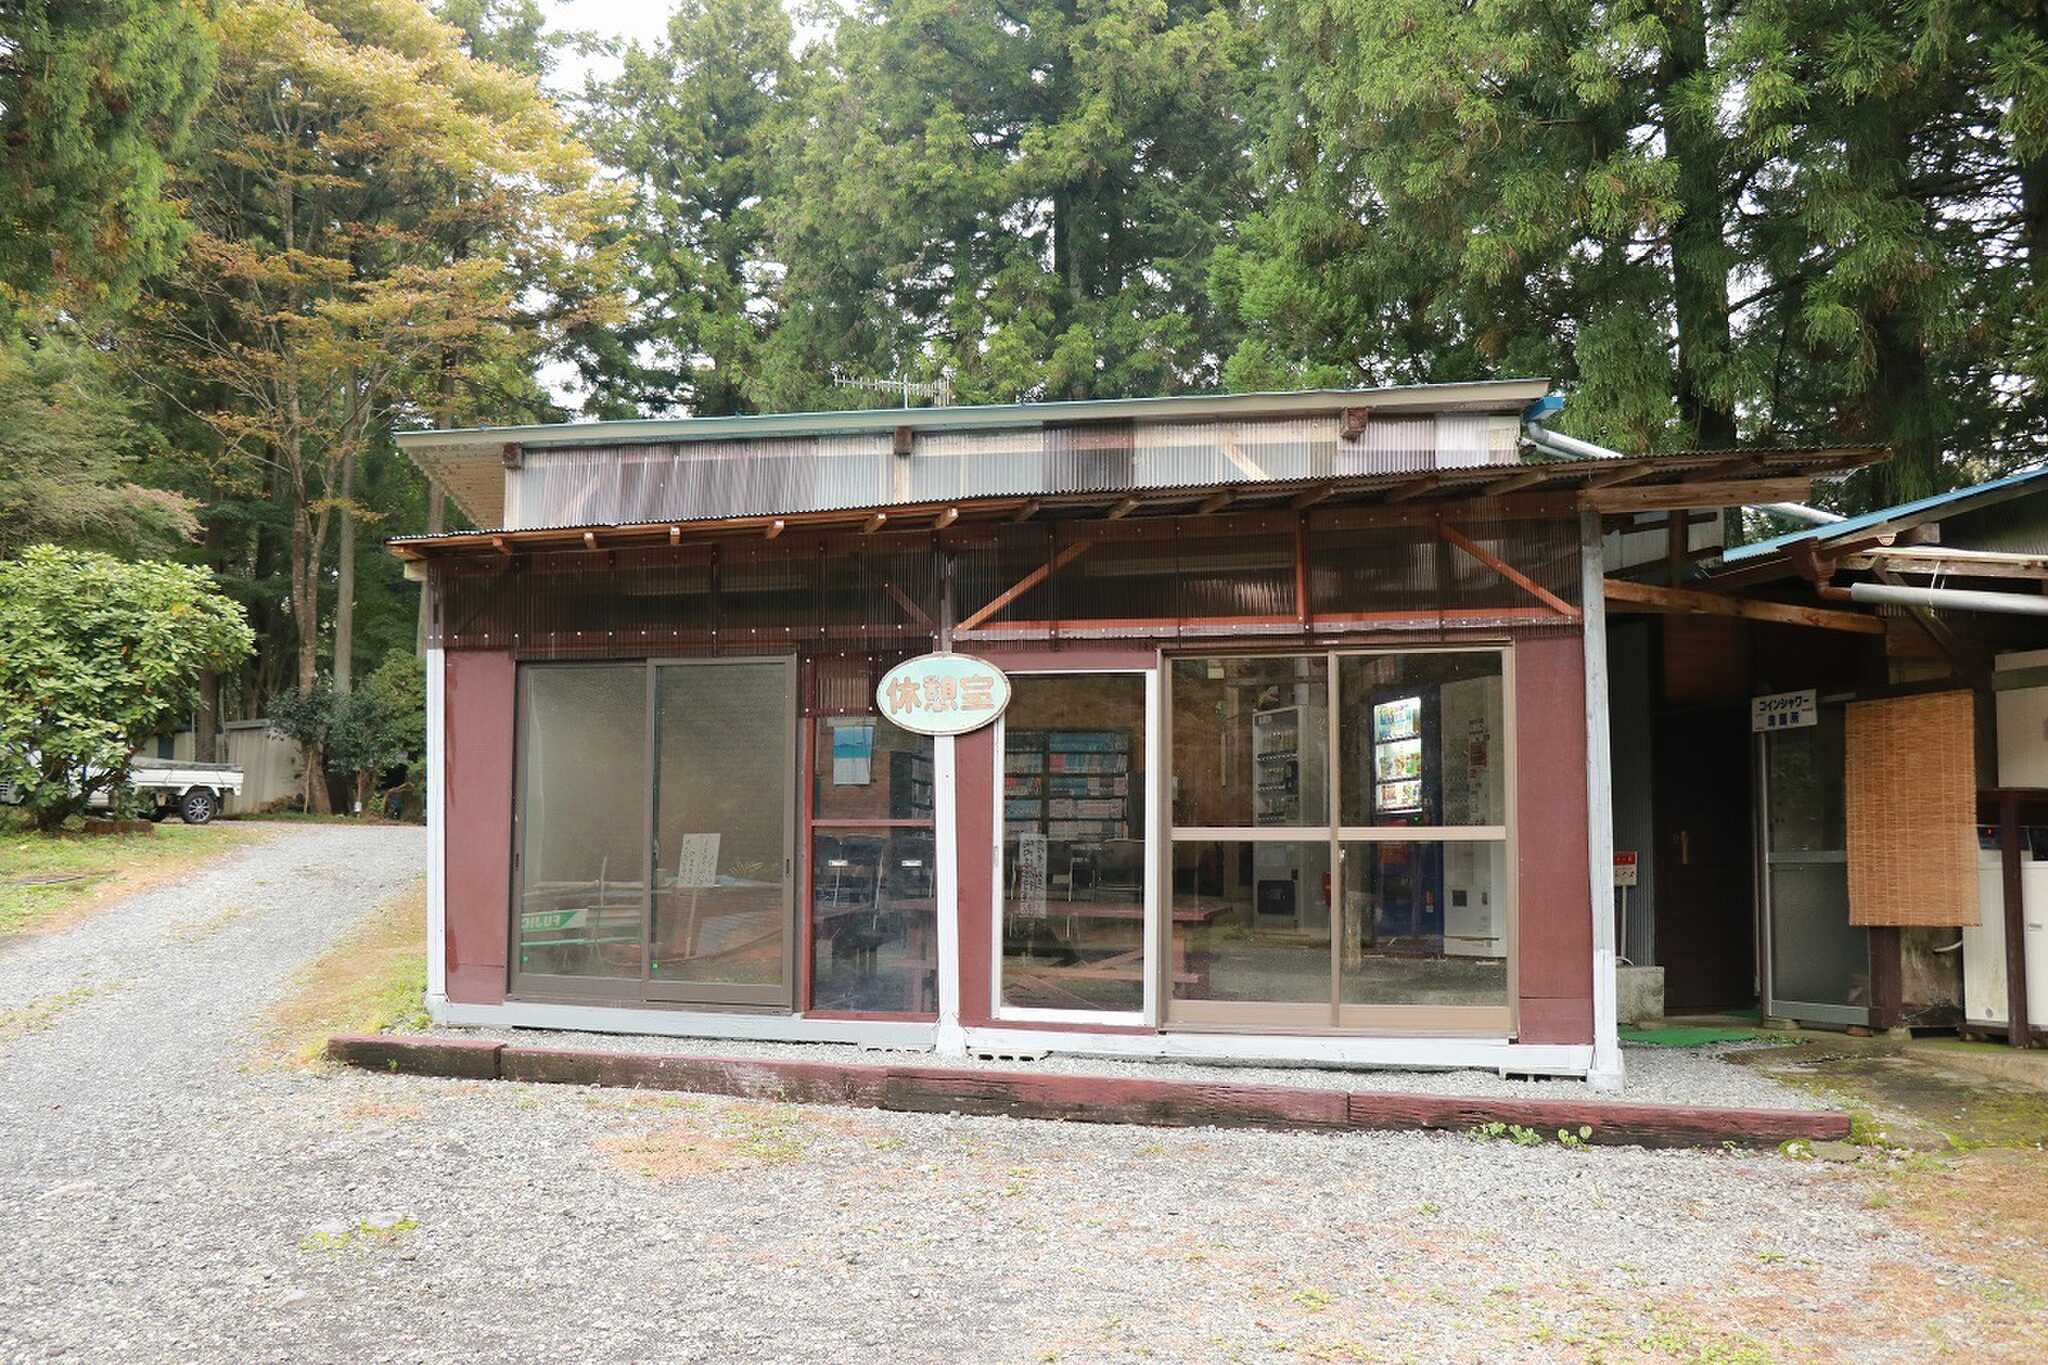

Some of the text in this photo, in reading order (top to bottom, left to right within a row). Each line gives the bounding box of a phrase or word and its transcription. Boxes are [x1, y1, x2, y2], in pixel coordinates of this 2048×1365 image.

[886, 674, 994, 715] 休憩室
[1759, 696, 1809, 711] コインシャワー
